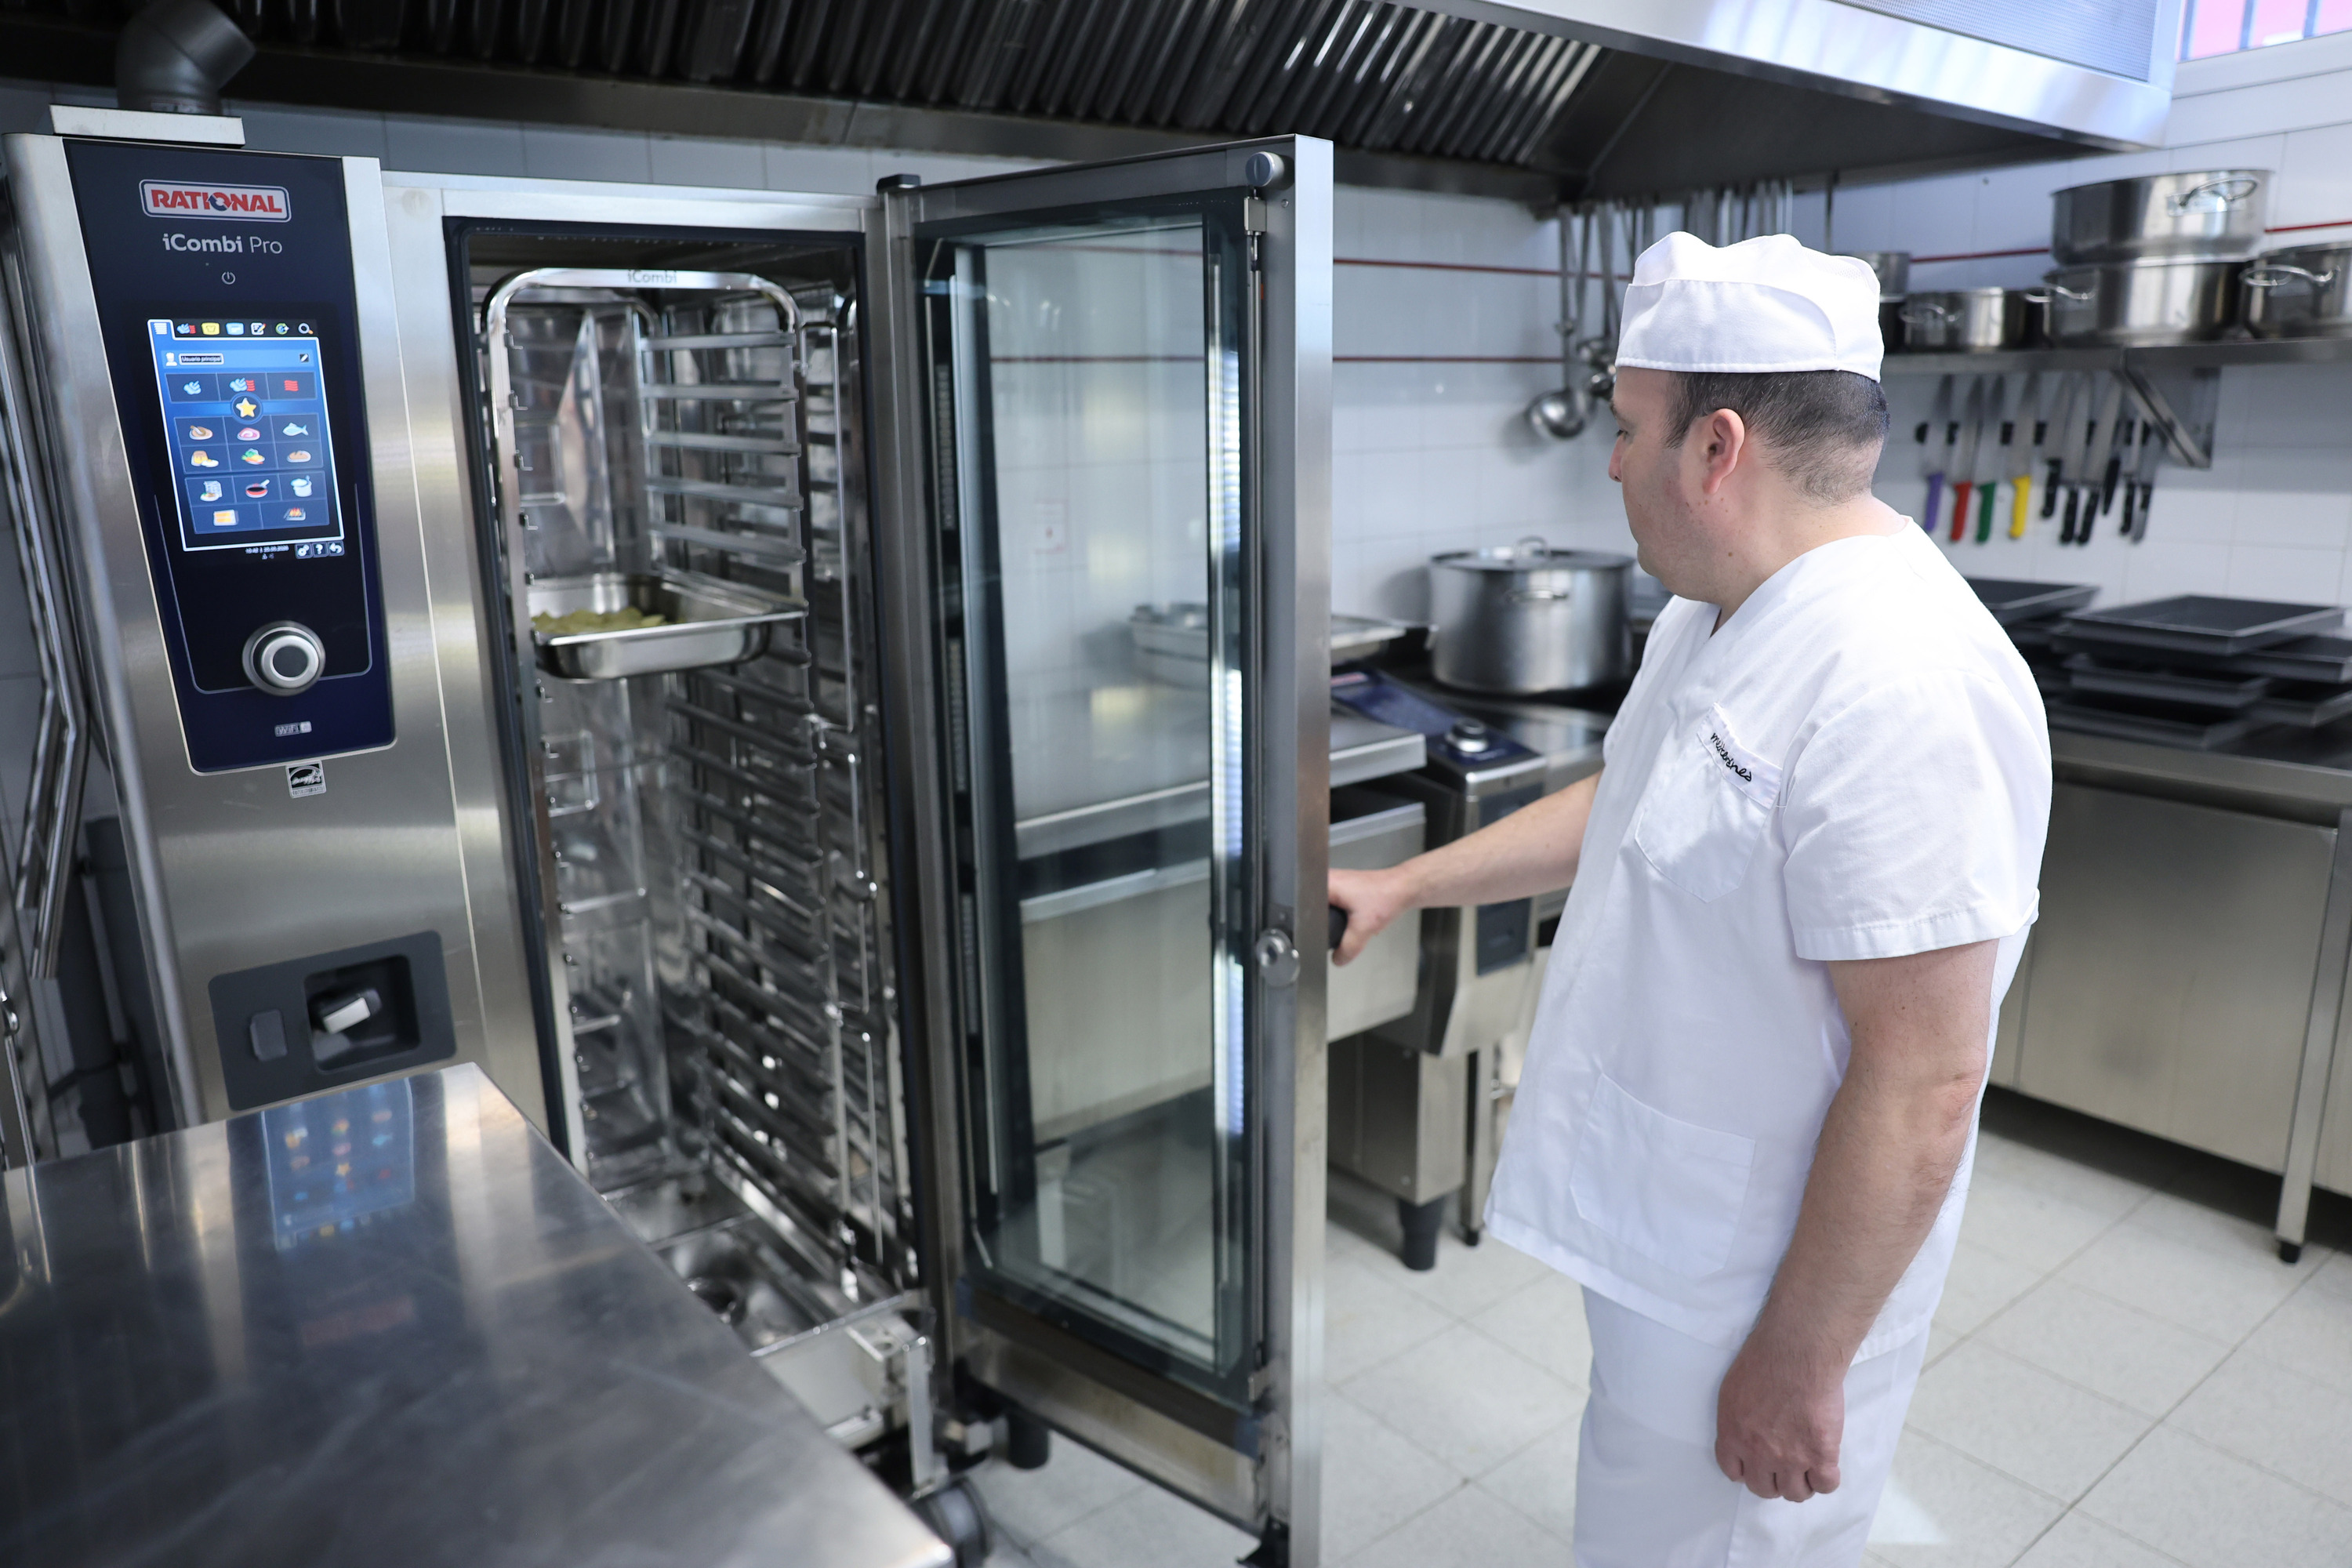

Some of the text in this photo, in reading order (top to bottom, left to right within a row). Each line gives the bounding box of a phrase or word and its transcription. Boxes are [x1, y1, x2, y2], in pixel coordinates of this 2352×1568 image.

[151, 189, 283, 213] RATIONAL
[162, 233, 283, 254] iCombi Pro
[628, 269, 678, 283] iCombi
